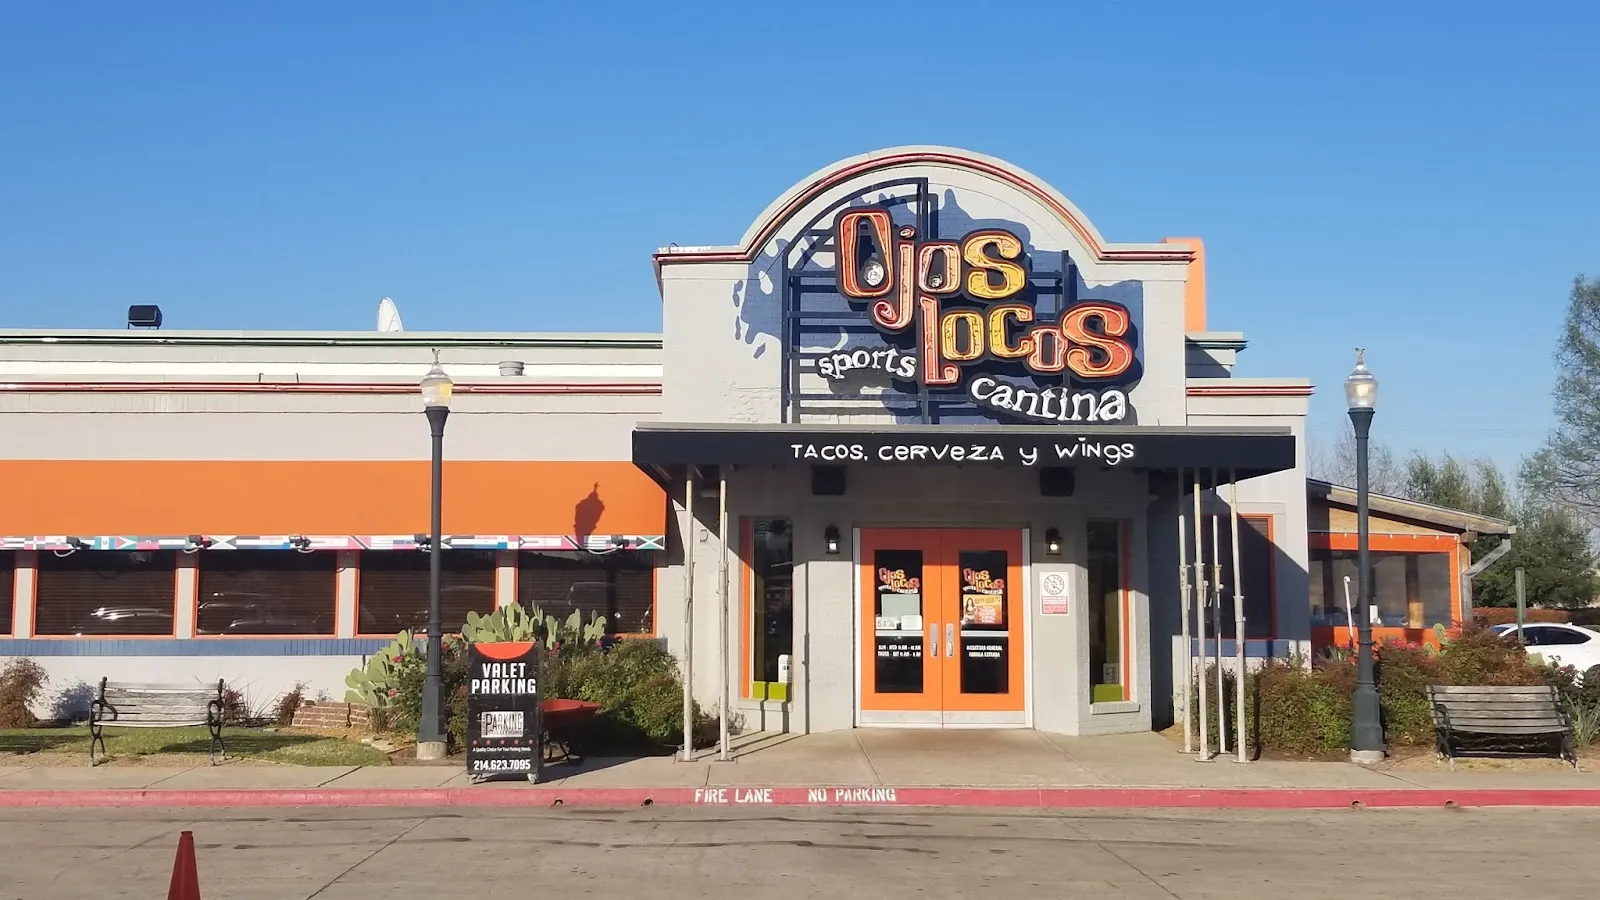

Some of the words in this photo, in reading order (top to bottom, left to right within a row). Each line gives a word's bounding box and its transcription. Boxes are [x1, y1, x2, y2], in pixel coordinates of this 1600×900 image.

[838, 208, 1026, 330] Ojos
[818, 346, 918, 380] sports
[970, 376, 1127, 422] cantina
[791, 443, 868, 461] TACOS,
[482, 663, 526, 678] VALET
[471, 679, 536, 694] PARKING
[485, 713, 523, 735] PARKING
[473, 760, 531, 770] 214.623.7095
[694, 789, 728, 803] FIRE
[735, 789, 773, 803] LANE
[808, 788, 827, 802] NO
[835, 788, 896, 802] PARKING
